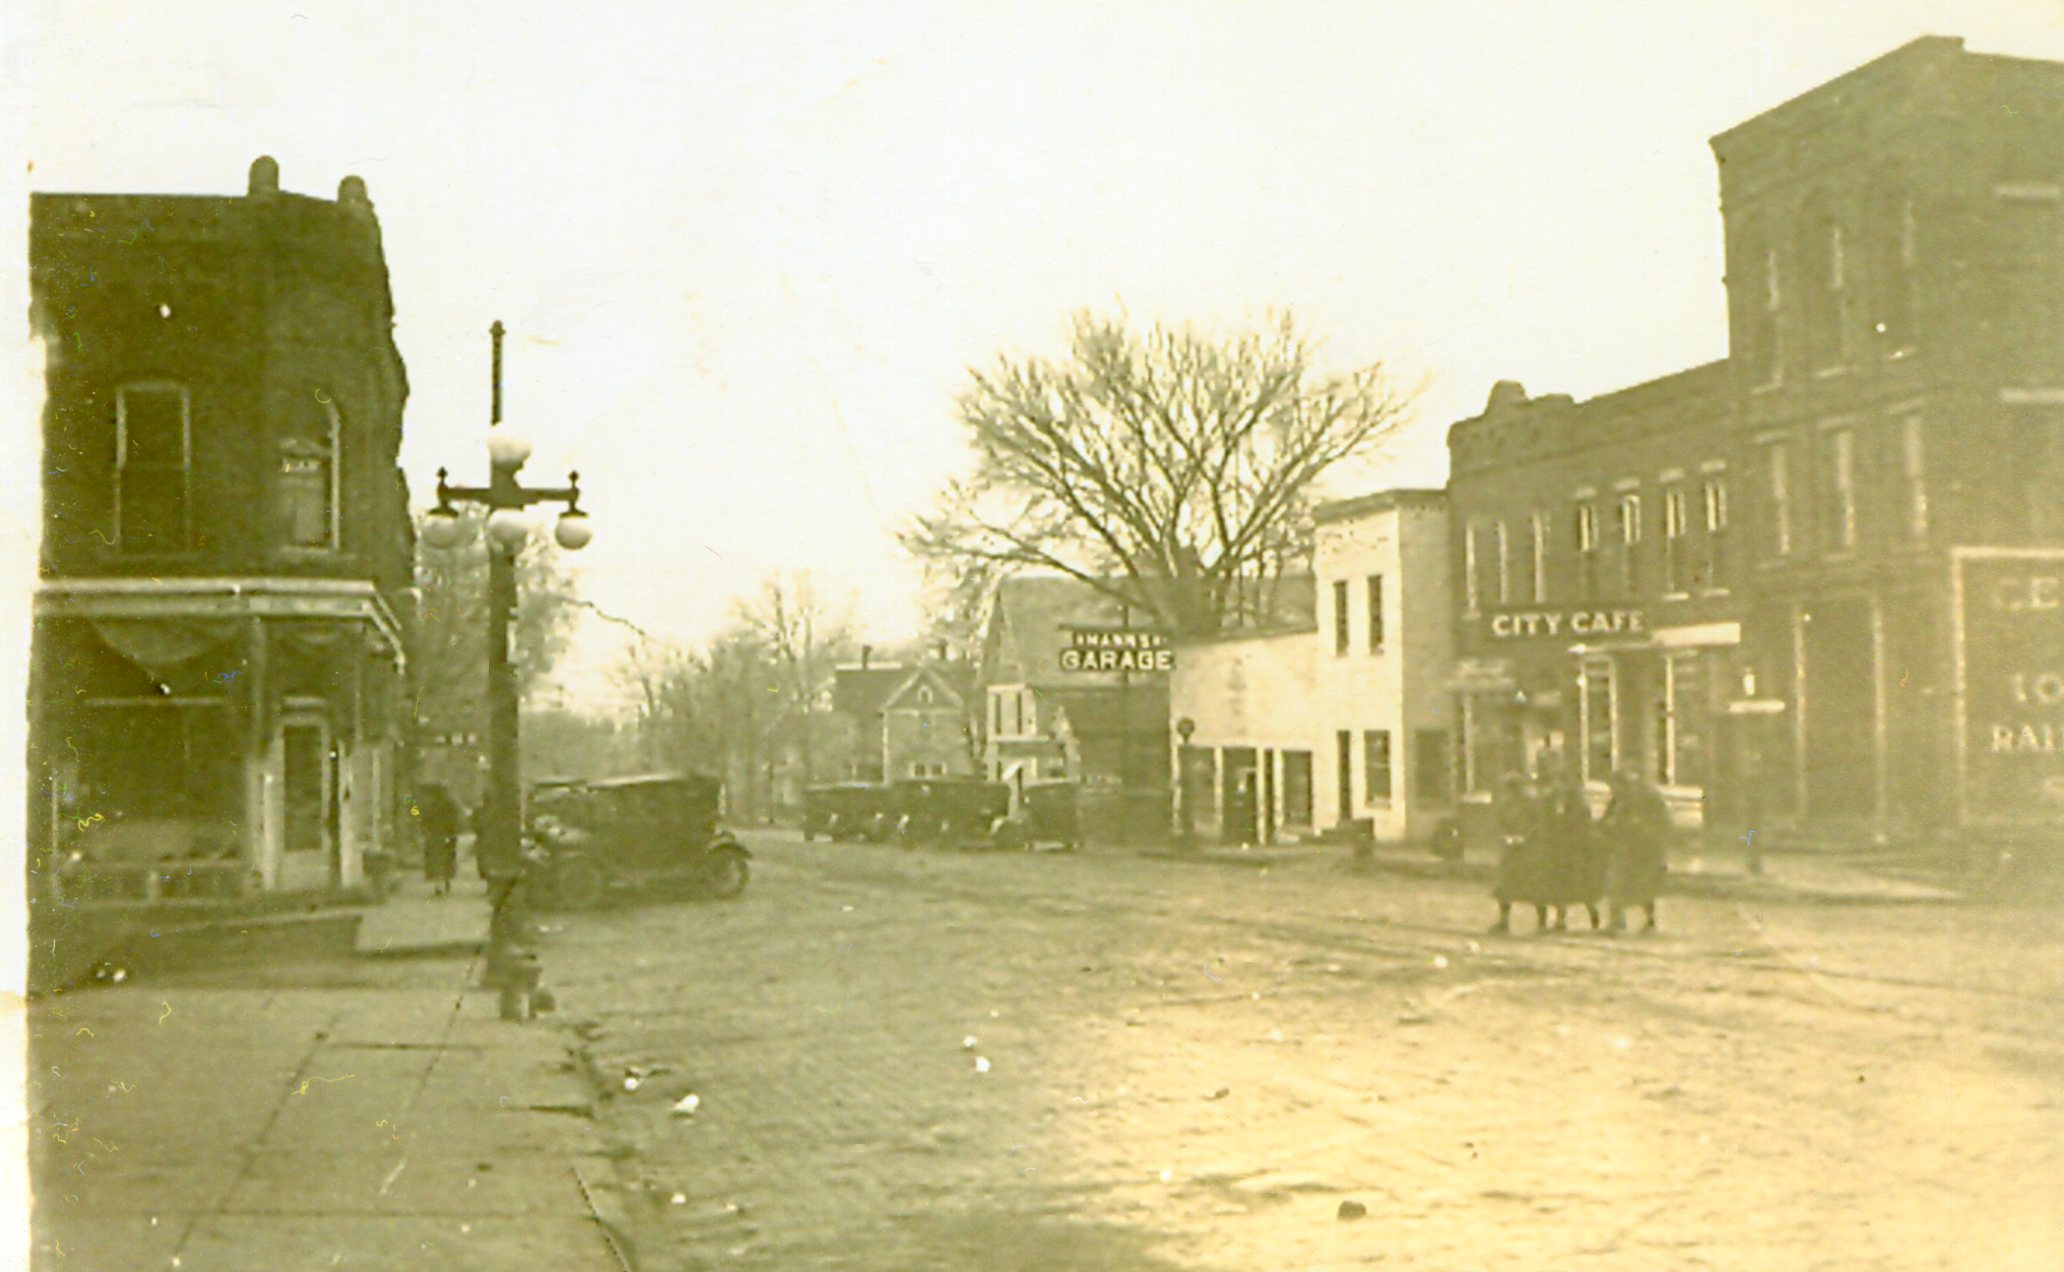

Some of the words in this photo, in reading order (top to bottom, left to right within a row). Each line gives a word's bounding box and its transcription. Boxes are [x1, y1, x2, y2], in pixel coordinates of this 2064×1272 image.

[1491, 612, 1562, 636] CITY
[1570, 610, 1644, 633] CAFE
[1061, 649, 1172, 670] GARAGE
